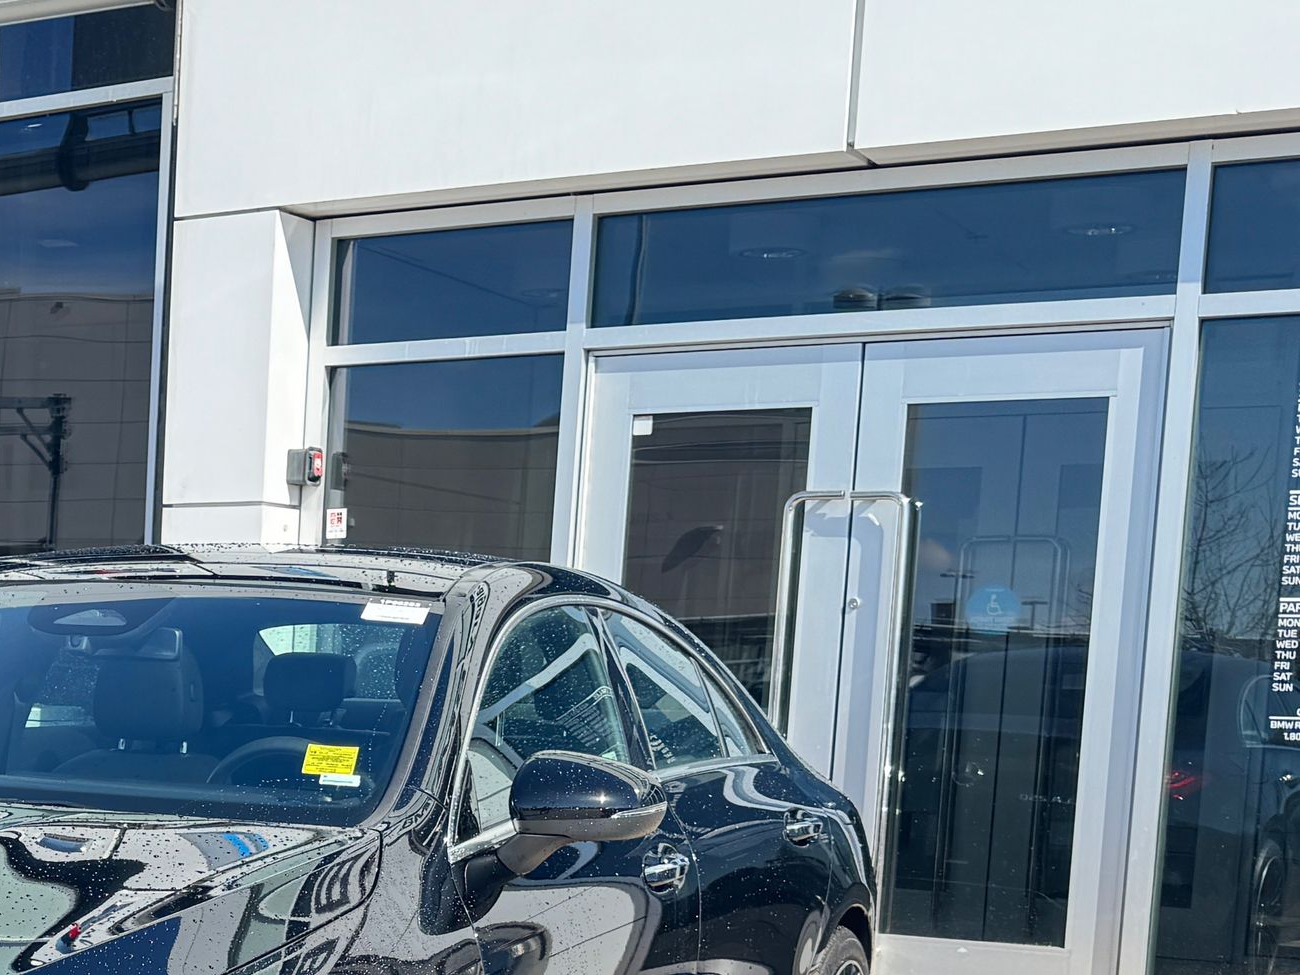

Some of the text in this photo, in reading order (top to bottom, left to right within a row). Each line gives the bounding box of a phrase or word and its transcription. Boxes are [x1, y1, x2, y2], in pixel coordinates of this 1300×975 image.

[1284, 554, 1300, 564] FRI
[1278, 618, 1300, 628] MON
[1277, 629, 1298, 638] TUE
[1276, 640, 1299, 649] WED
[1275, 650, 1297, 660] THU
[1274, 661, 1290, 670] FRI
[1273, 672, 1292, 681] SAT
[1272, 683, 1294, 692] SUN
[1270, 720, 1294, 729] BMW
